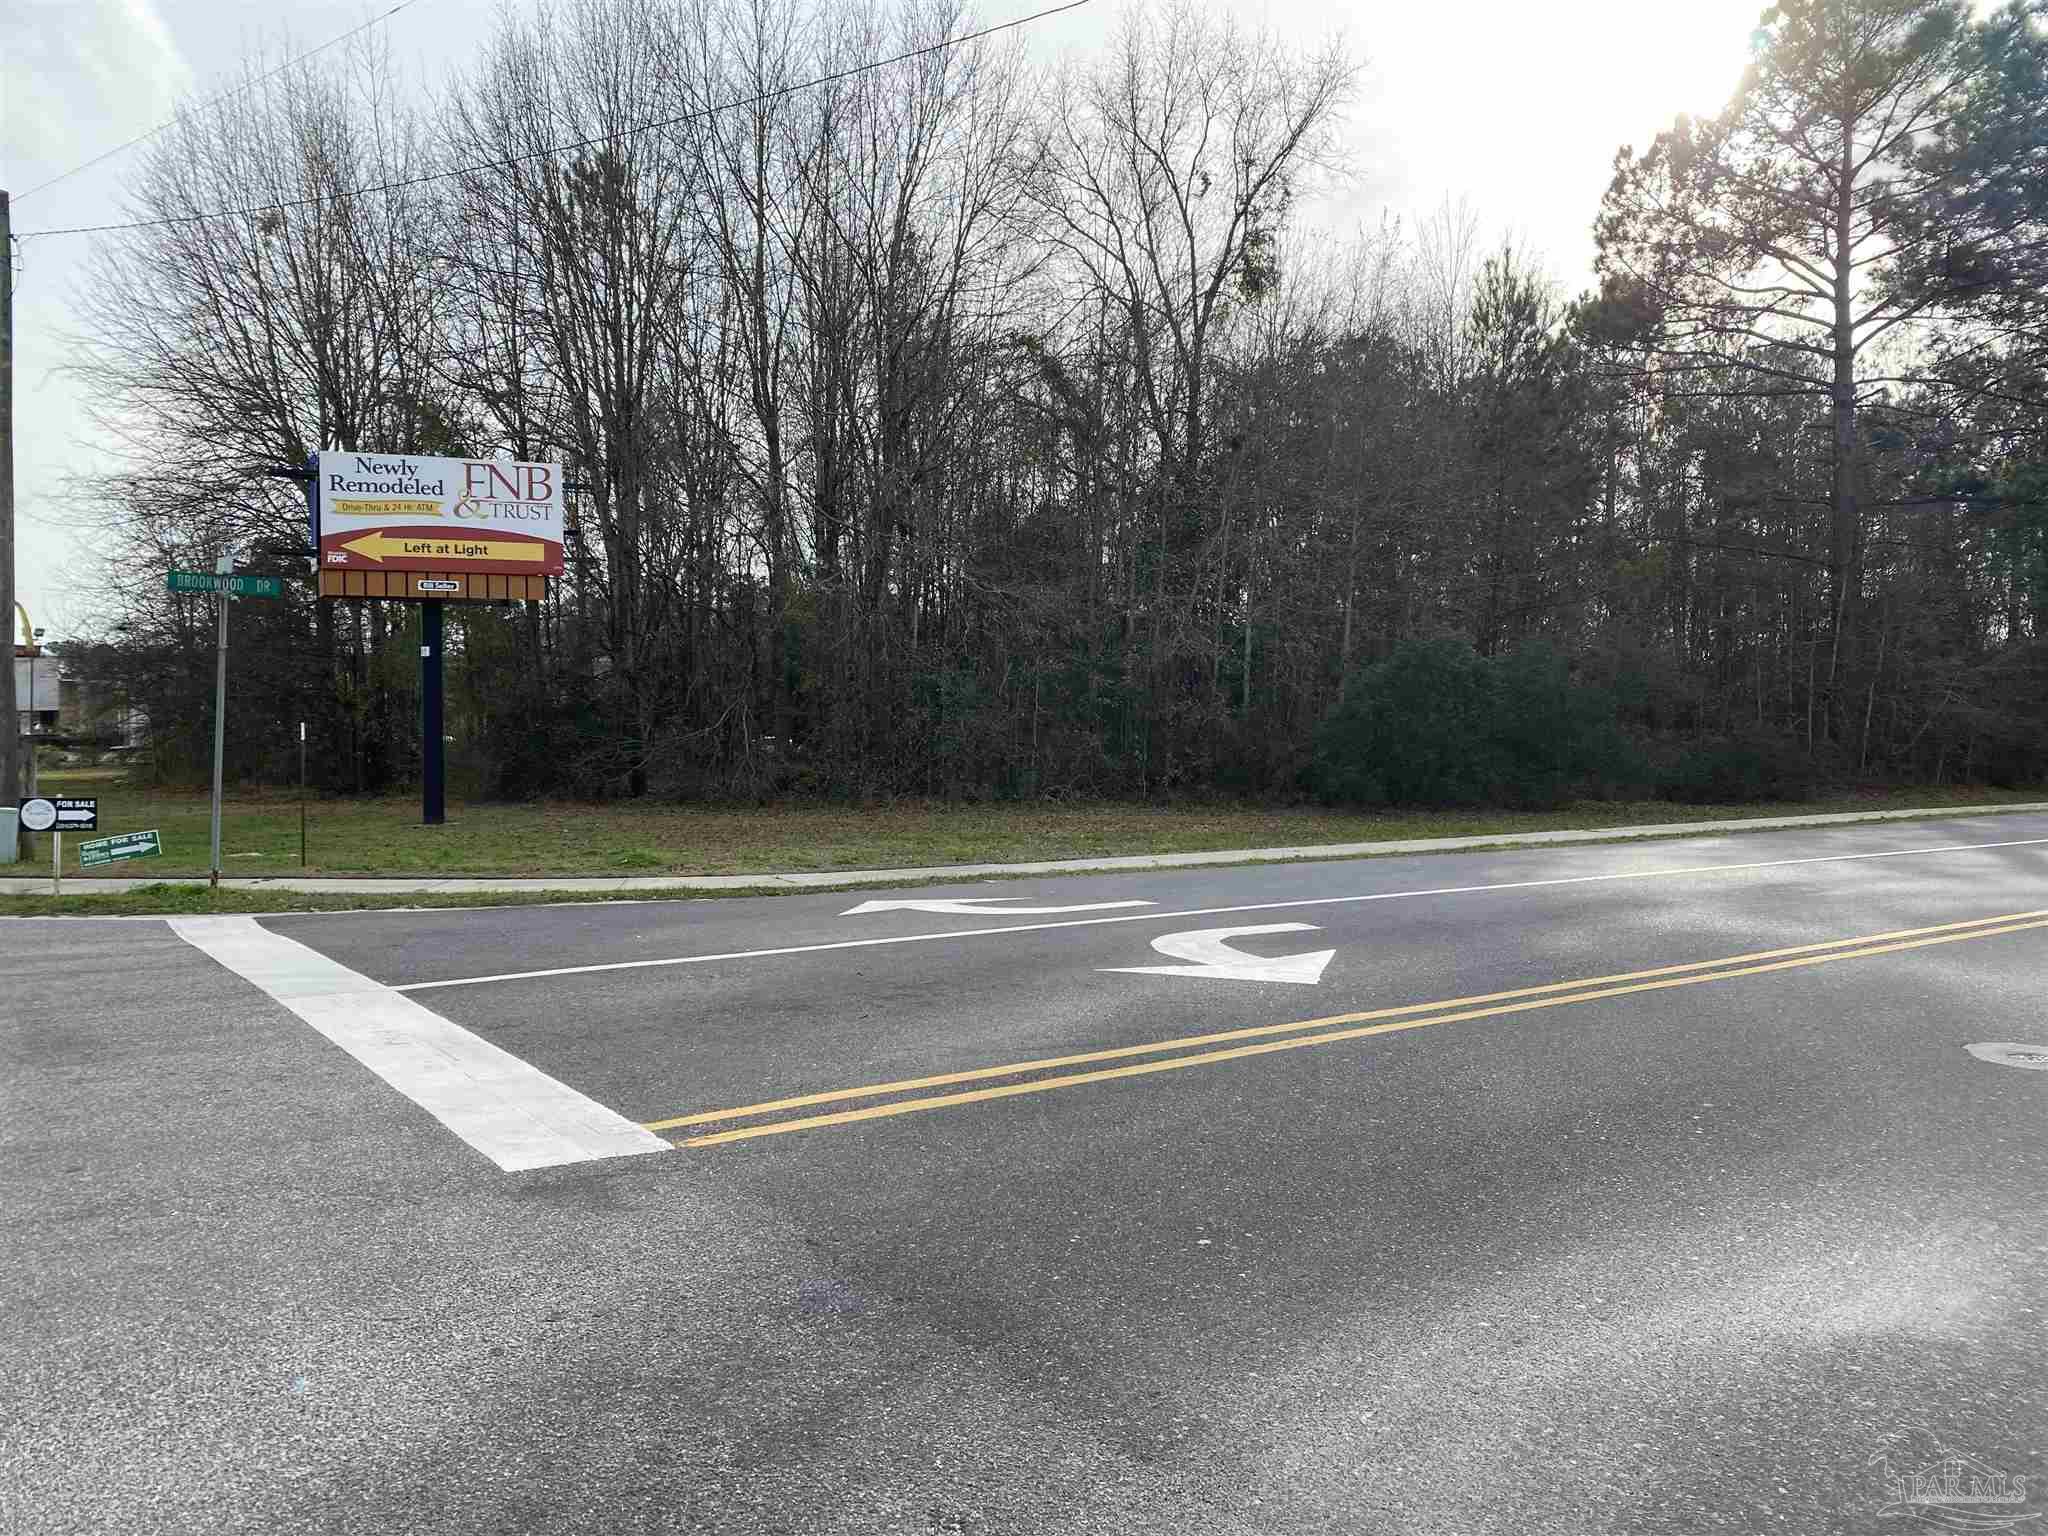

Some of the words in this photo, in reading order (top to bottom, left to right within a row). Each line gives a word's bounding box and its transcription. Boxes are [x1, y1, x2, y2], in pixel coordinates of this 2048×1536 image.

[356, 457, 418, 478] Newly
[329, 474, 444, 496] Remodeled
[462, 462, 553, 501] FNB
[415, 503, 433, 512] ATM
[453, 489, 488, 519] &
[488, 502, 553, 521] TRUST
[404, 542, 437, 554] Left
[441, 544, 452, 555] at
[454, 543, 489, 557] Light
[328, 554, 348, 563] FDIC
[256, 579, 272, 593] DR
[56, 800, 73, 808] FOR
[75, 800, 95, 808] SALE
[111, 837, 129, 845] FOR
[131, 832, 154, 842] SALE
